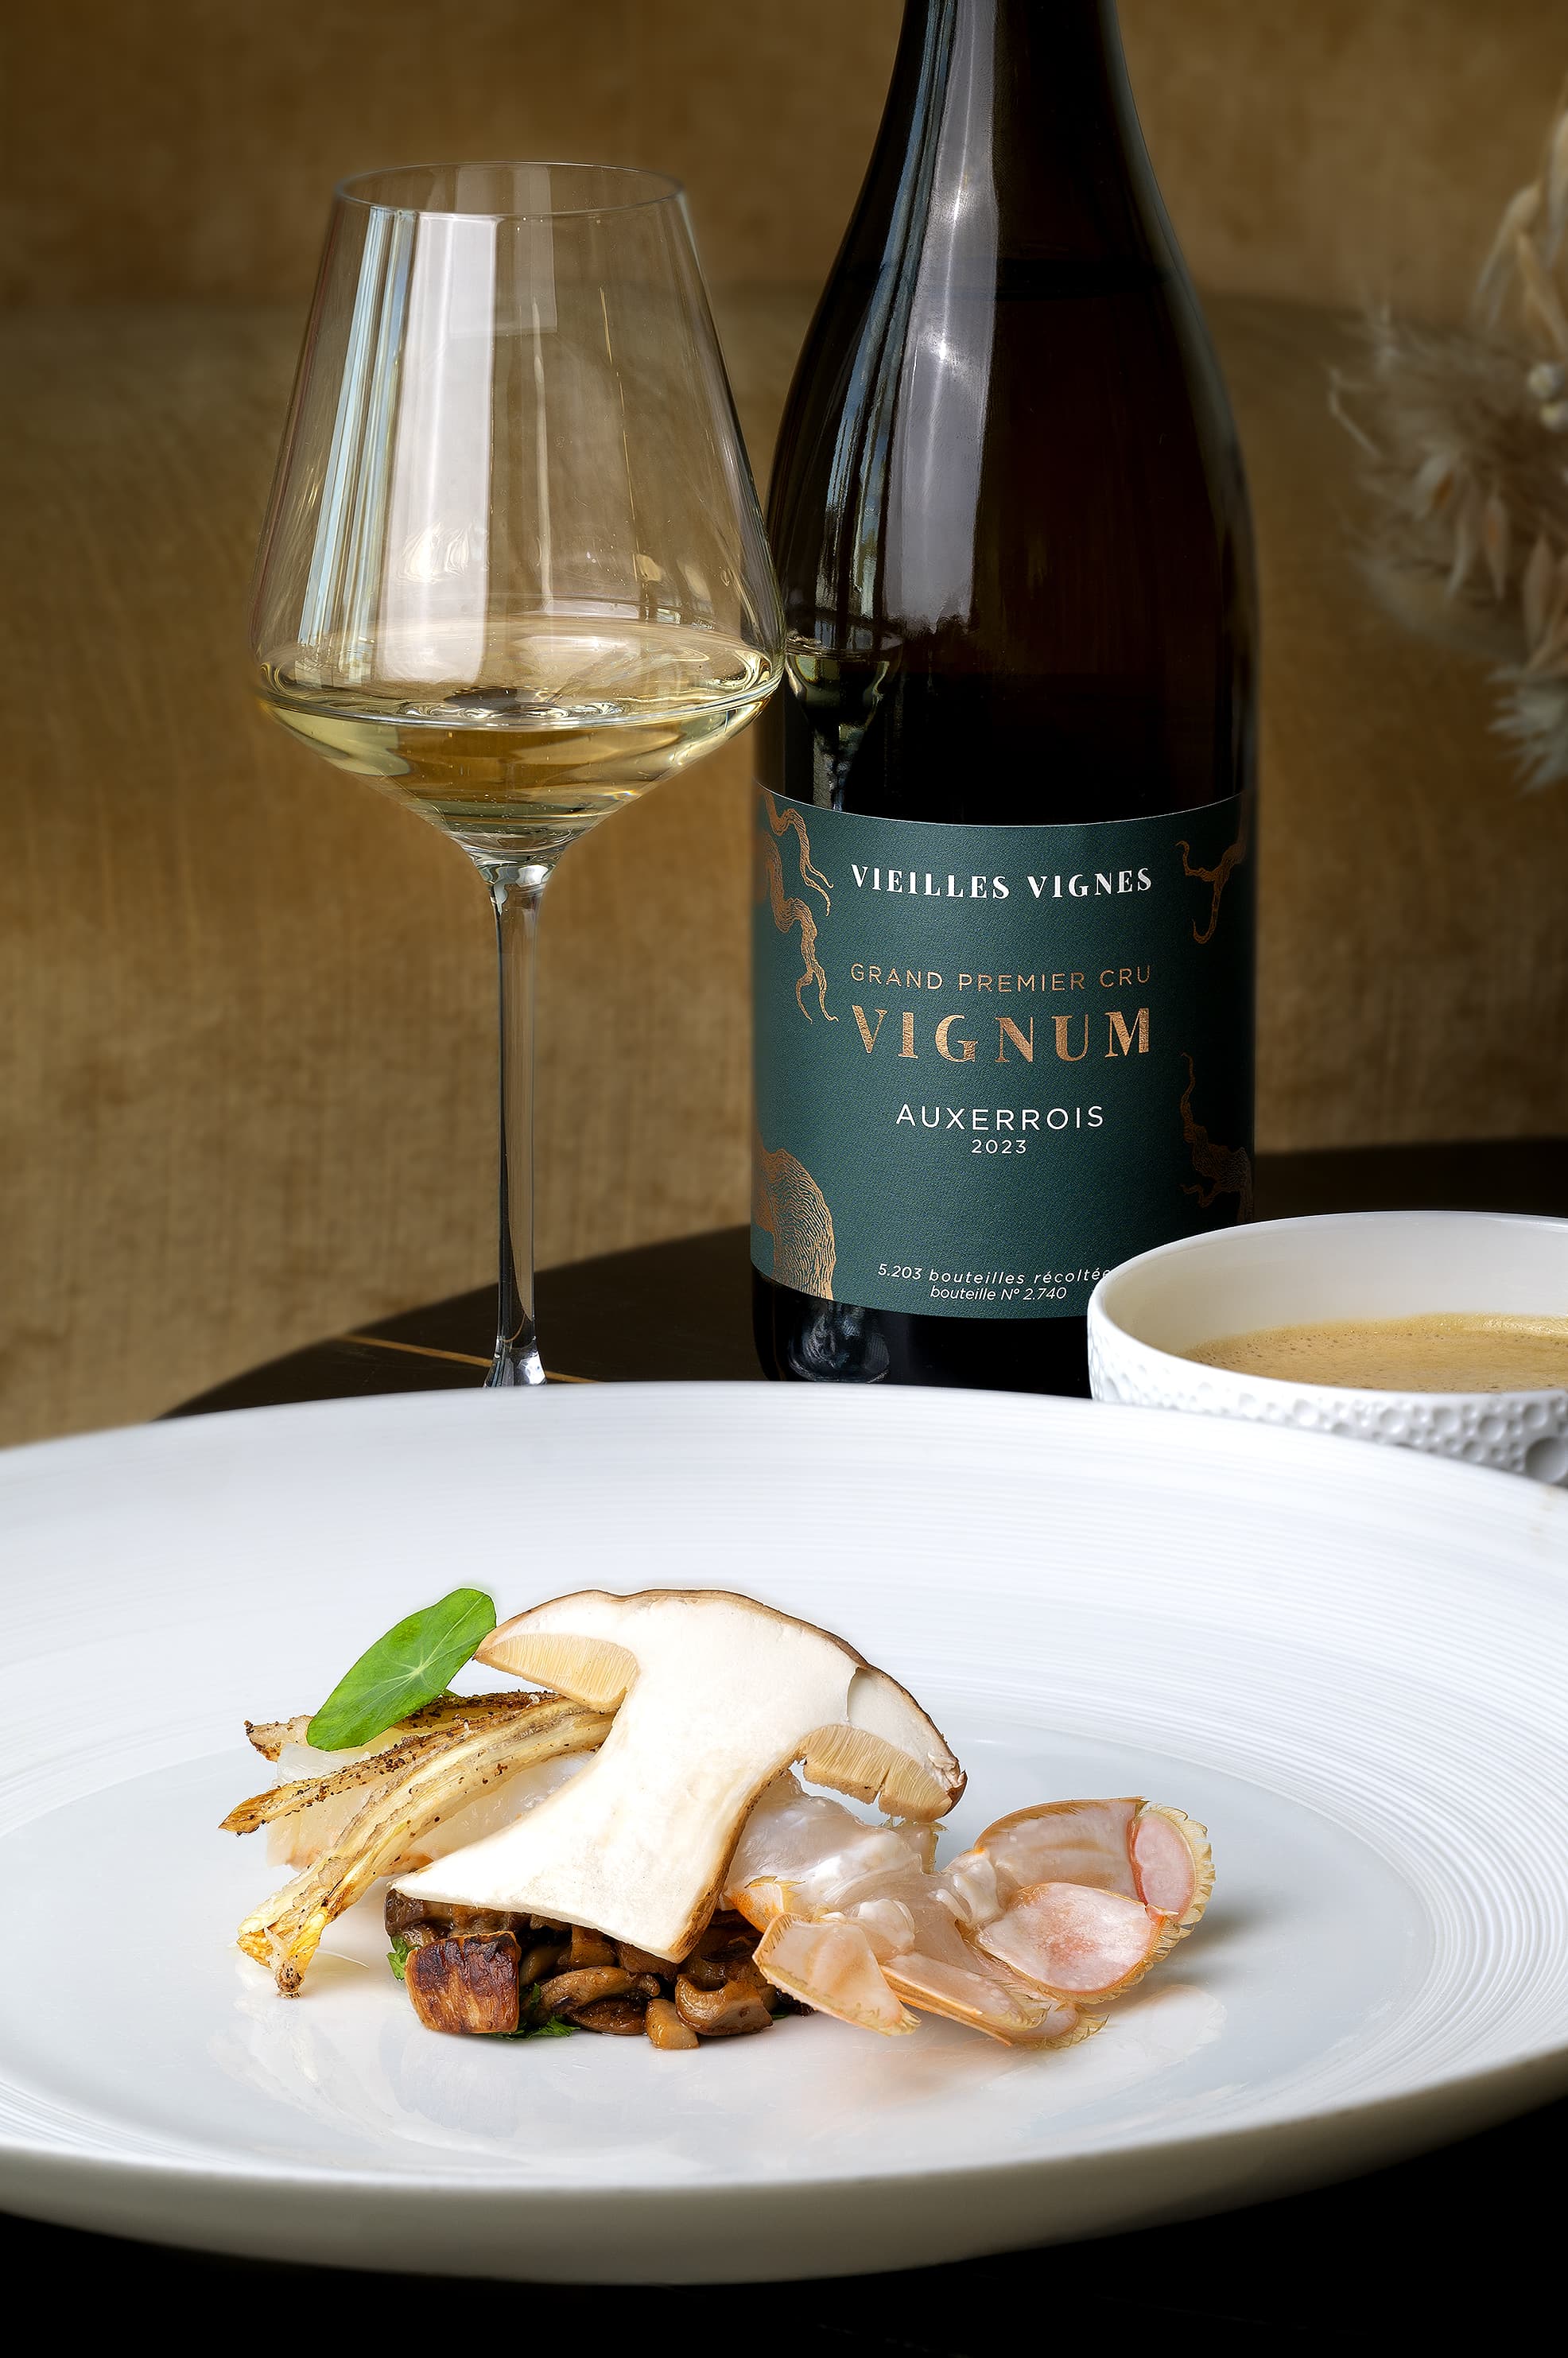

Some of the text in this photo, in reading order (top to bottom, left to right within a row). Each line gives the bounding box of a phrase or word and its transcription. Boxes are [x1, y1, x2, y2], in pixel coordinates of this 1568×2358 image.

[851, 864, 1152, 899] VIEILLES VIGNES
[851, 963, 1151, 993] GRAND PREMIER CRU
[851, 1004, 1150, 1063] VIGNUM
[895, 1103, 1104, 1131] AUXERROIS
[971, 1139, 1027, 1154] 2023
[878, 1263, 922, 1280] 5.203
[929, 1269, 1025, 1284] bouteilles
[930, 1285, 996, 1300] bouteille
[1023, 1287, 1067, 1301] 2.740
